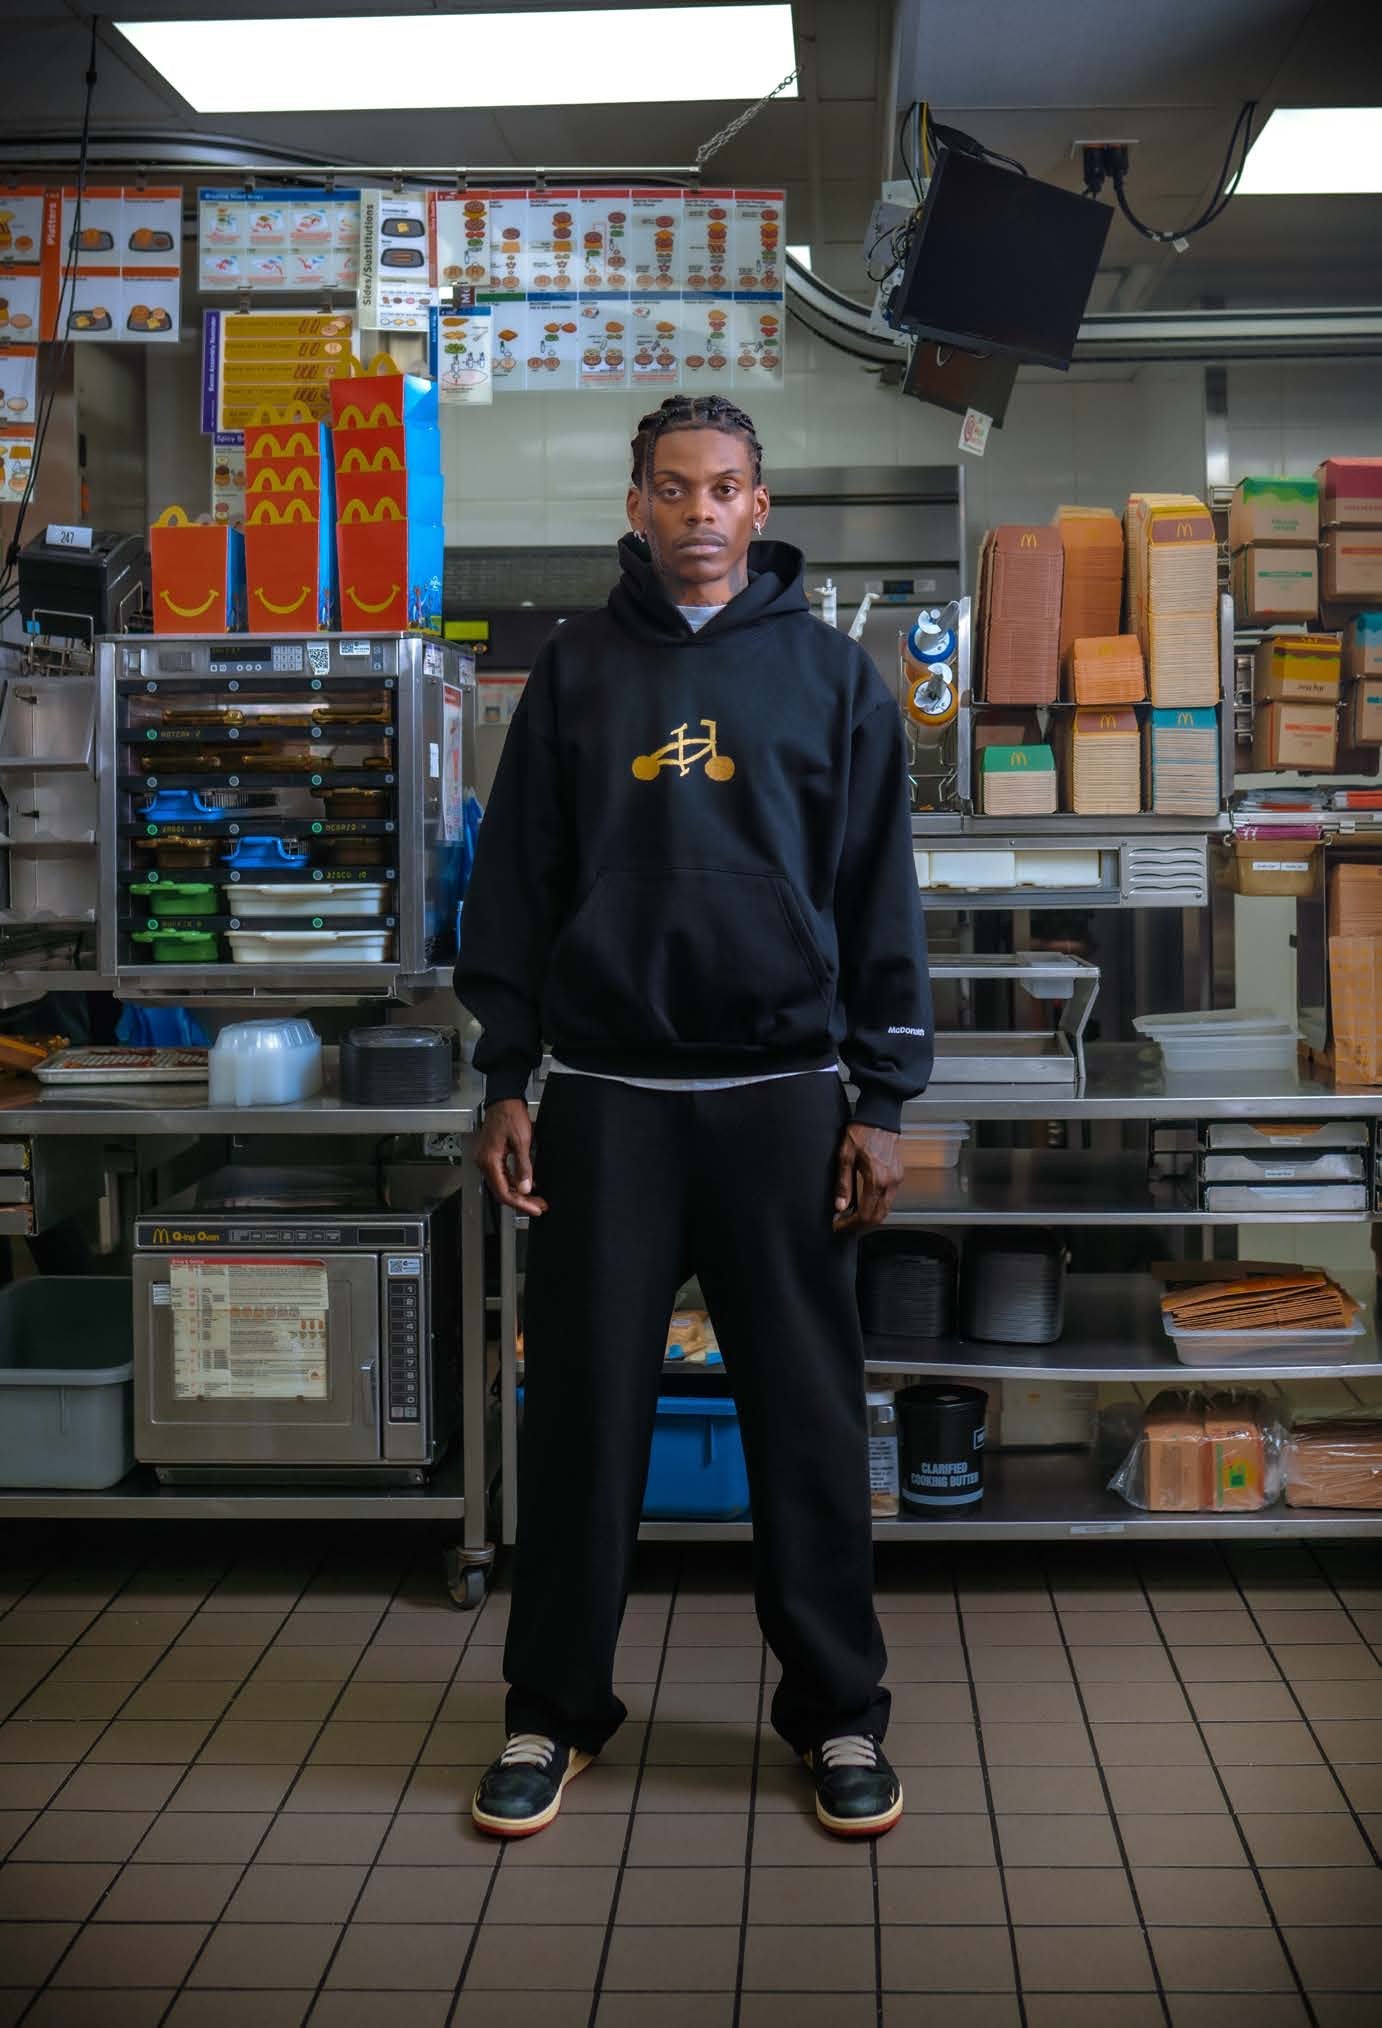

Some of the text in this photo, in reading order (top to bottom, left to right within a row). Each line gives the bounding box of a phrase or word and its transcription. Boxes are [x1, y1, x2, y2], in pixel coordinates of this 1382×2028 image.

[362, 204, 374, 306] Sides/Substitutions
[60, 531, 75, 544] 247
[921, 1462, 968, 1474] CLARIFIED
[911, 1473, 948, 1487] COOKING
